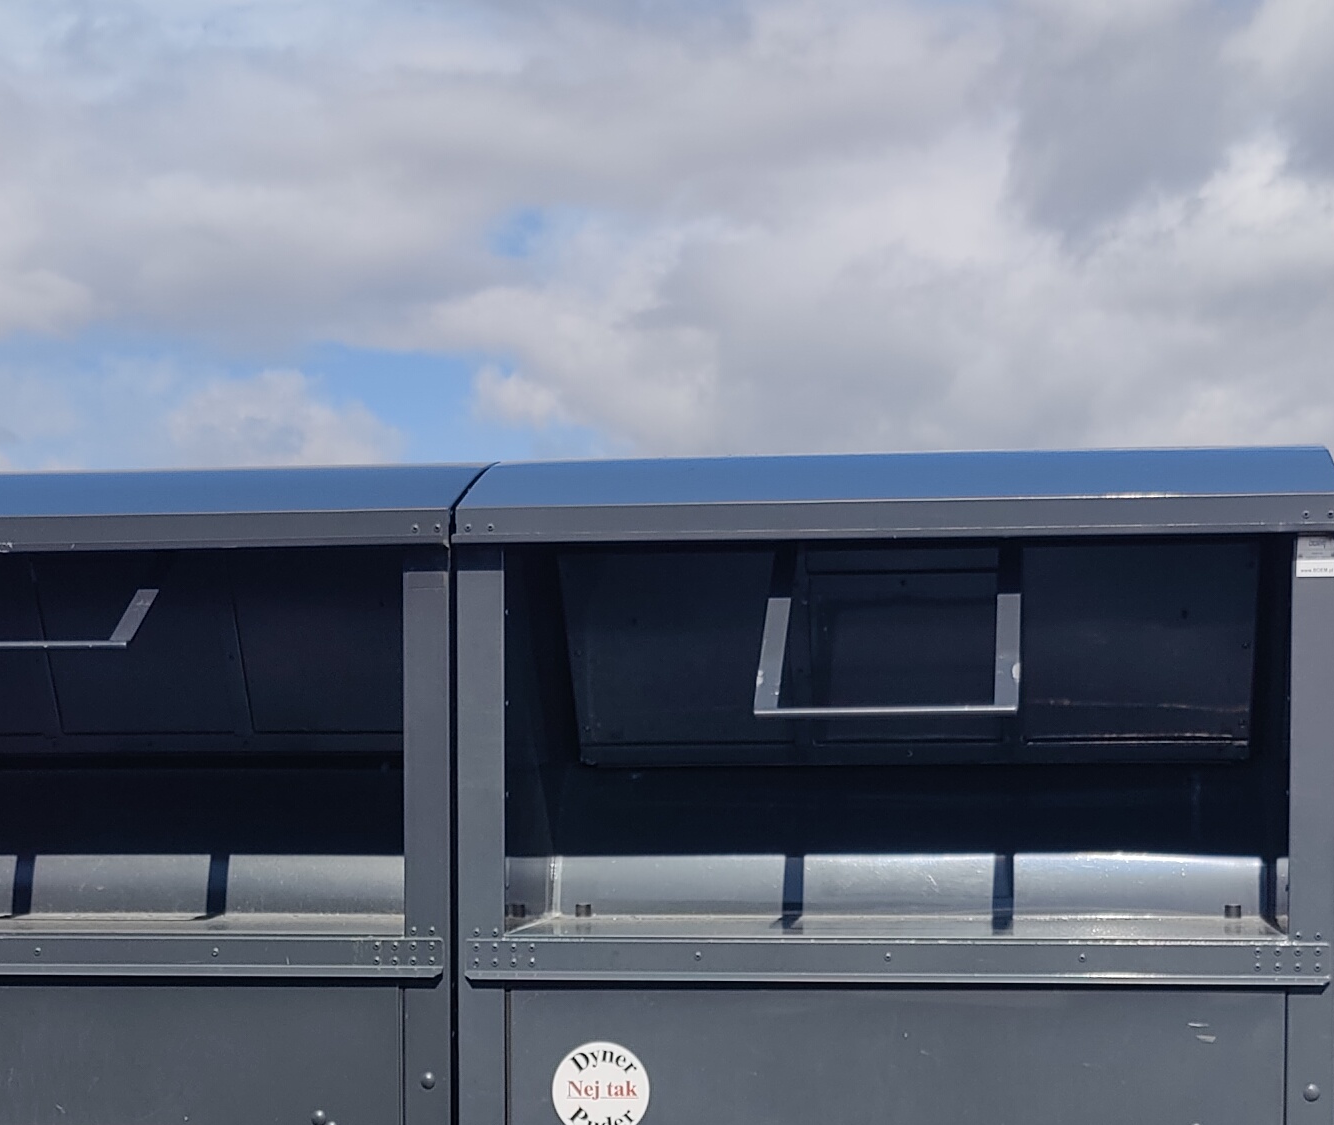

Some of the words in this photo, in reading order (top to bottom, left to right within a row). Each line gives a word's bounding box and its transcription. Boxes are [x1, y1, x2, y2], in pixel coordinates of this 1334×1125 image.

[570, 1050, 637, 1074] Dyner
[567, 1080, 599, 1100] Nej
[607, 1081, 637, 1096] tak
